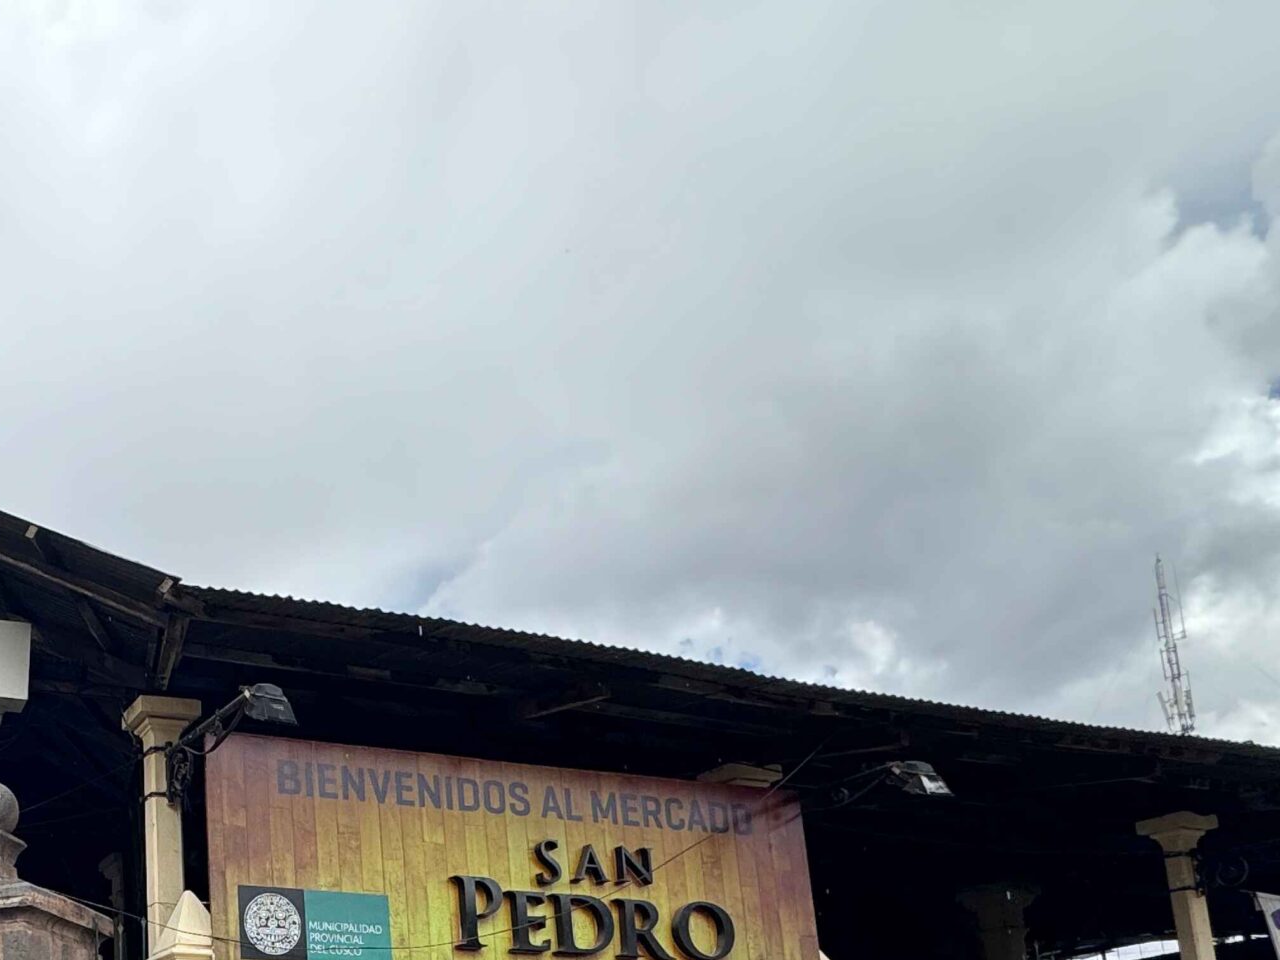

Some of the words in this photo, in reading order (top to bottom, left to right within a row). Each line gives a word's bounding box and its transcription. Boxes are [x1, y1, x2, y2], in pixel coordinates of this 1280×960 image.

[276, 759, 531, 817] BIENVENIDOS
[541, 786, 583, 821] AL
[592, 791, 753, 836] MERCADO
[534, 840, 655, 887] SAN
[308, 921, 382, 935] MUNICIPALIDAD
[309, 932, 365, 945] PROVINCIAL
[310, 944, 327, 954] DEL
[330, 946, 362, 956] CUSCO
